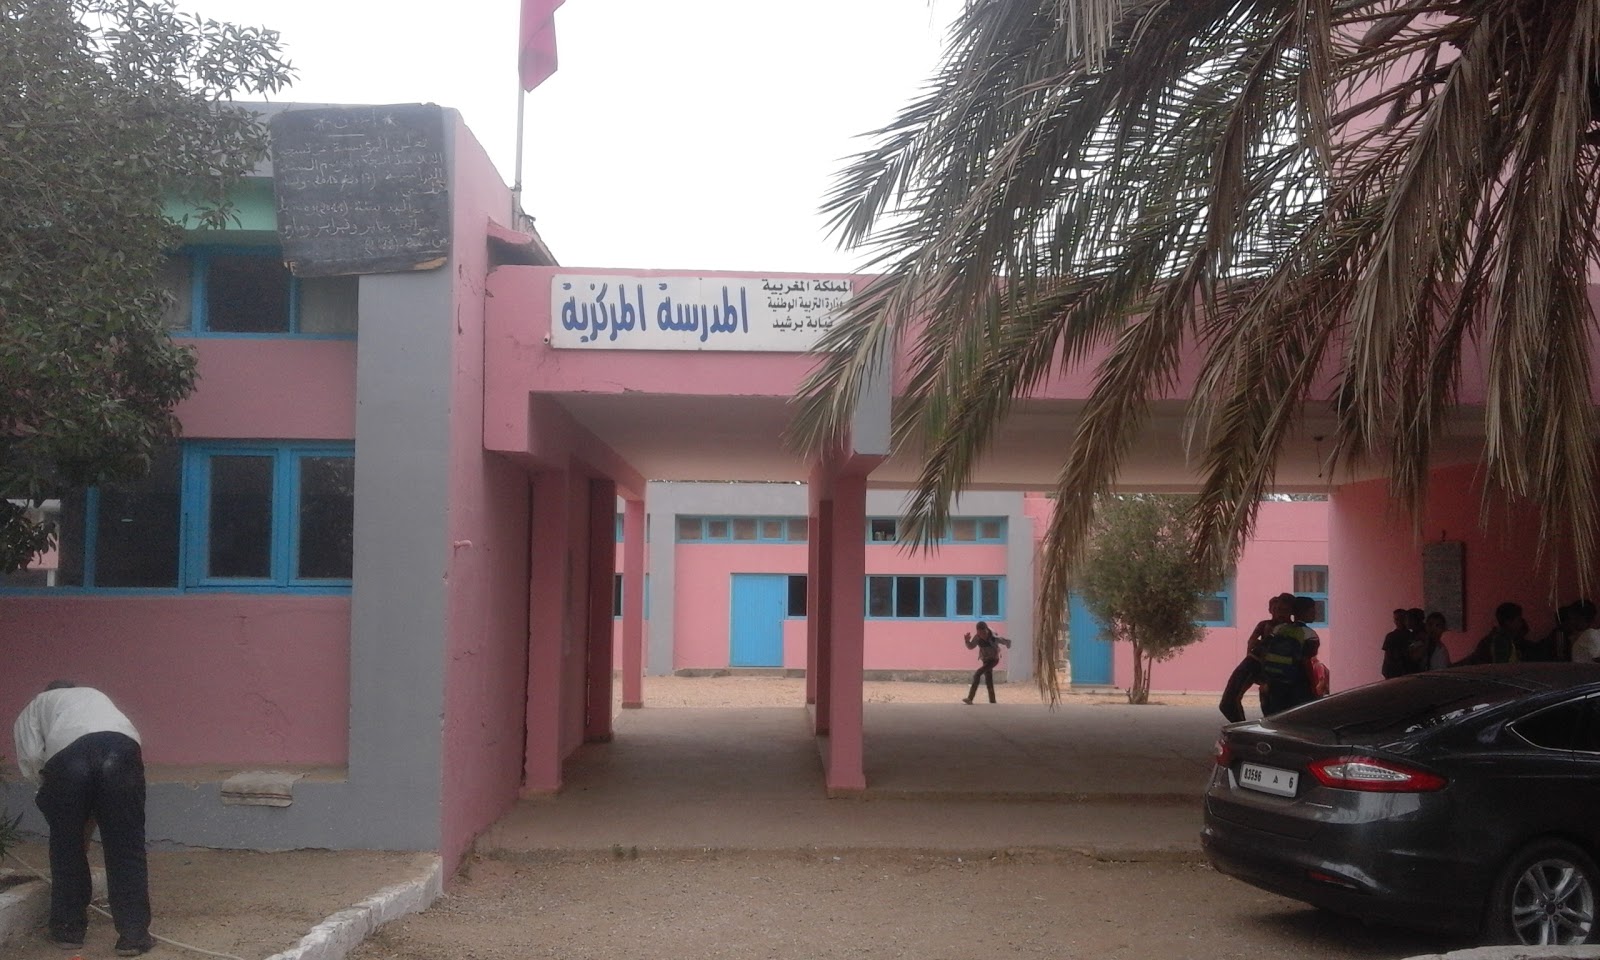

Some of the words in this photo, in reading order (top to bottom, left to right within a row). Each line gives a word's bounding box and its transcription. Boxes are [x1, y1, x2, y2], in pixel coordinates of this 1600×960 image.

[761, 278, 810, 295] المغربية
[813, 279, 852, 293] المملكة
[561, 281, 647, 343] المركزية
[656, 282, 749, 343] المدرسة
[767, 296, 798, 313] الوطنية
[799, 296, 825, 313] التربية
[772, 315, 804, 333] برشيد
[806, 315, 834, 333] نيابة
[1288, 777, 1294, 789] 6
